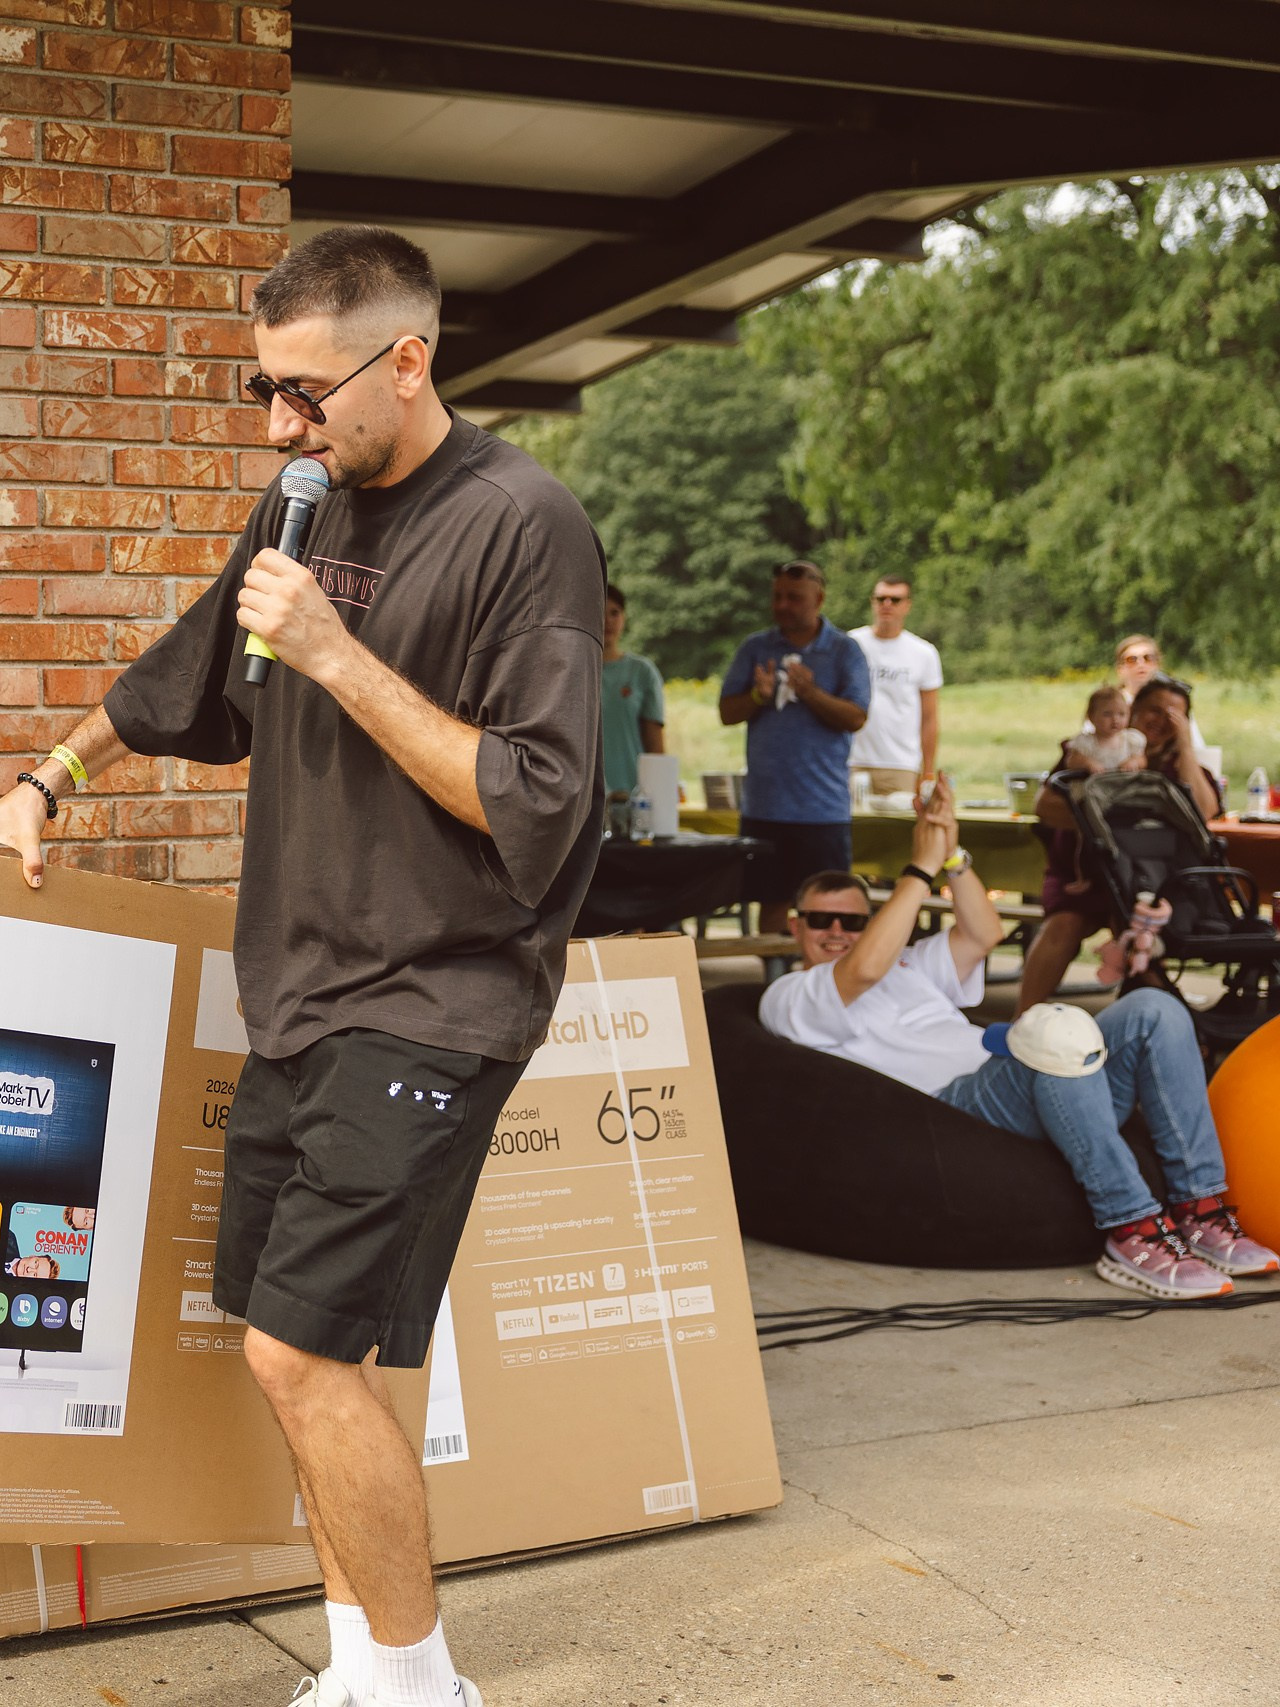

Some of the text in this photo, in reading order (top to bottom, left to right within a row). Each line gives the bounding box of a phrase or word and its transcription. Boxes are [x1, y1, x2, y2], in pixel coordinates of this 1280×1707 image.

[544, 1011, 649, 1045] tal UHD
[206, 1080, 235, 1095] 2026
[25, 1087, 50, 1108] TV
[500, 1108, 540, 1122] Model
[6, 1126, 13, 1135] AN
[665, 1129, 687, 1139] CLASS
[194, 1179, 215, 1187] Endless
[480, 1193, 516, 1203] Thousands
[525, 1190, 540, 1198] free
[541, 1187, 571, 1196] channels
[481, 1200, 541, 1212] Endless Free Content
[191, 1214, 210, 1222] Crystal
[484, 1229, 492, 1237] 3D
[494, 1227, 511, 1235] color
[512, 1223, 543, 1233] mapping
[550, 1219, 582, 1231] upscaling
[583, 1217, 592, 1225] for
[593, 1215, 613, 1224] clarity
[35, 1230, 88, 1246] CONAN
[34, 1243, 86, 1255] O'BRIEN TV
[185, 1259, 211, 1270] Smart
[634, 1269, 639, 1278] 3
[682, 1261, 708, 1272] PORTS
[609, 1267, 616, 1280] 7
[492, 1278, 529, 1290] Smart TV
[533, 1270, 594, 1294] TIZEN
[492, 1289, 532, 1299] Powered by
[594, 1306, 623, 1318] ESPN
[503, 1317, 534, 1330] NETFLIX
[225, 1343, 241, 1351] Google
